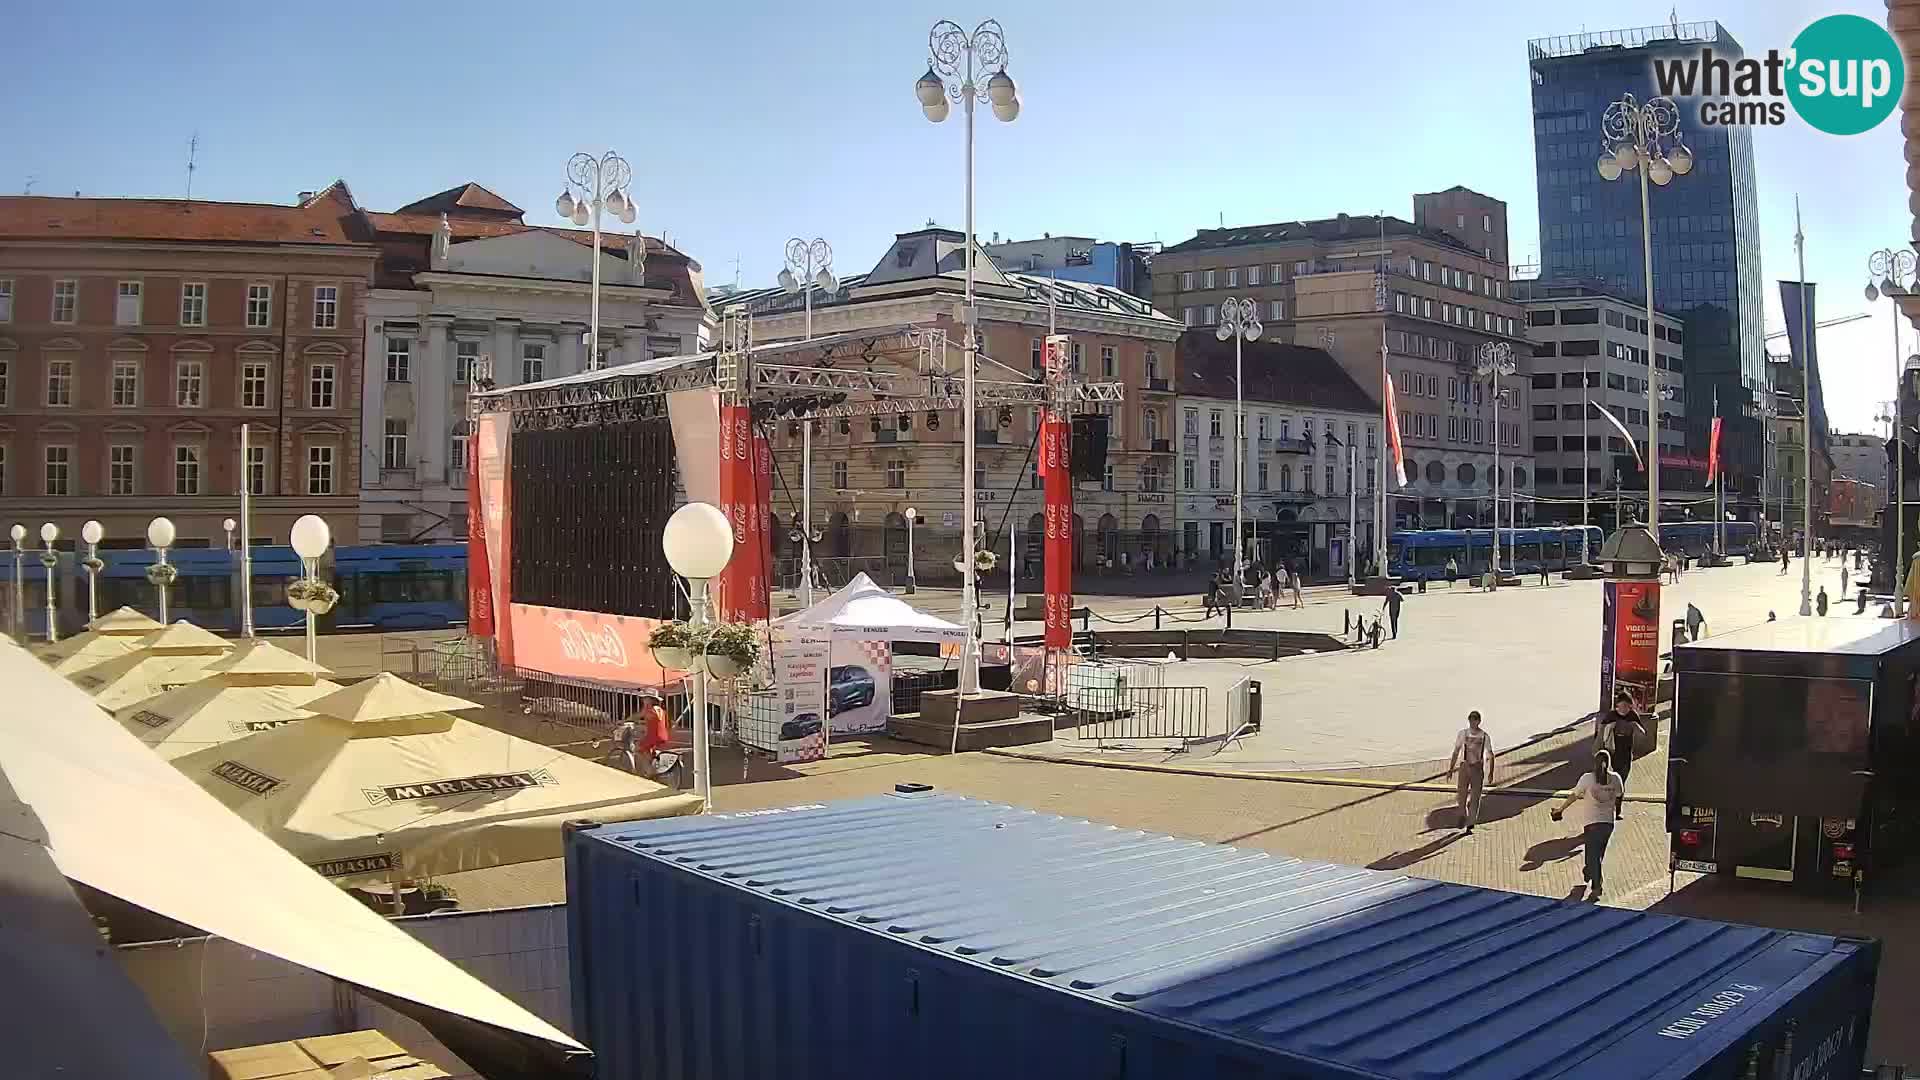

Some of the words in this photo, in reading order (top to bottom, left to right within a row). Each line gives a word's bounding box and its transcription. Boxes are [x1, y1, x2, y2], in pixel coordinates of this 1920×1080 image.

[735, 419, 748, 460] Coca-Cola
[735, 501, 747, 544] Coca-Cola
[394, 774, 532, 800] MARASKA
